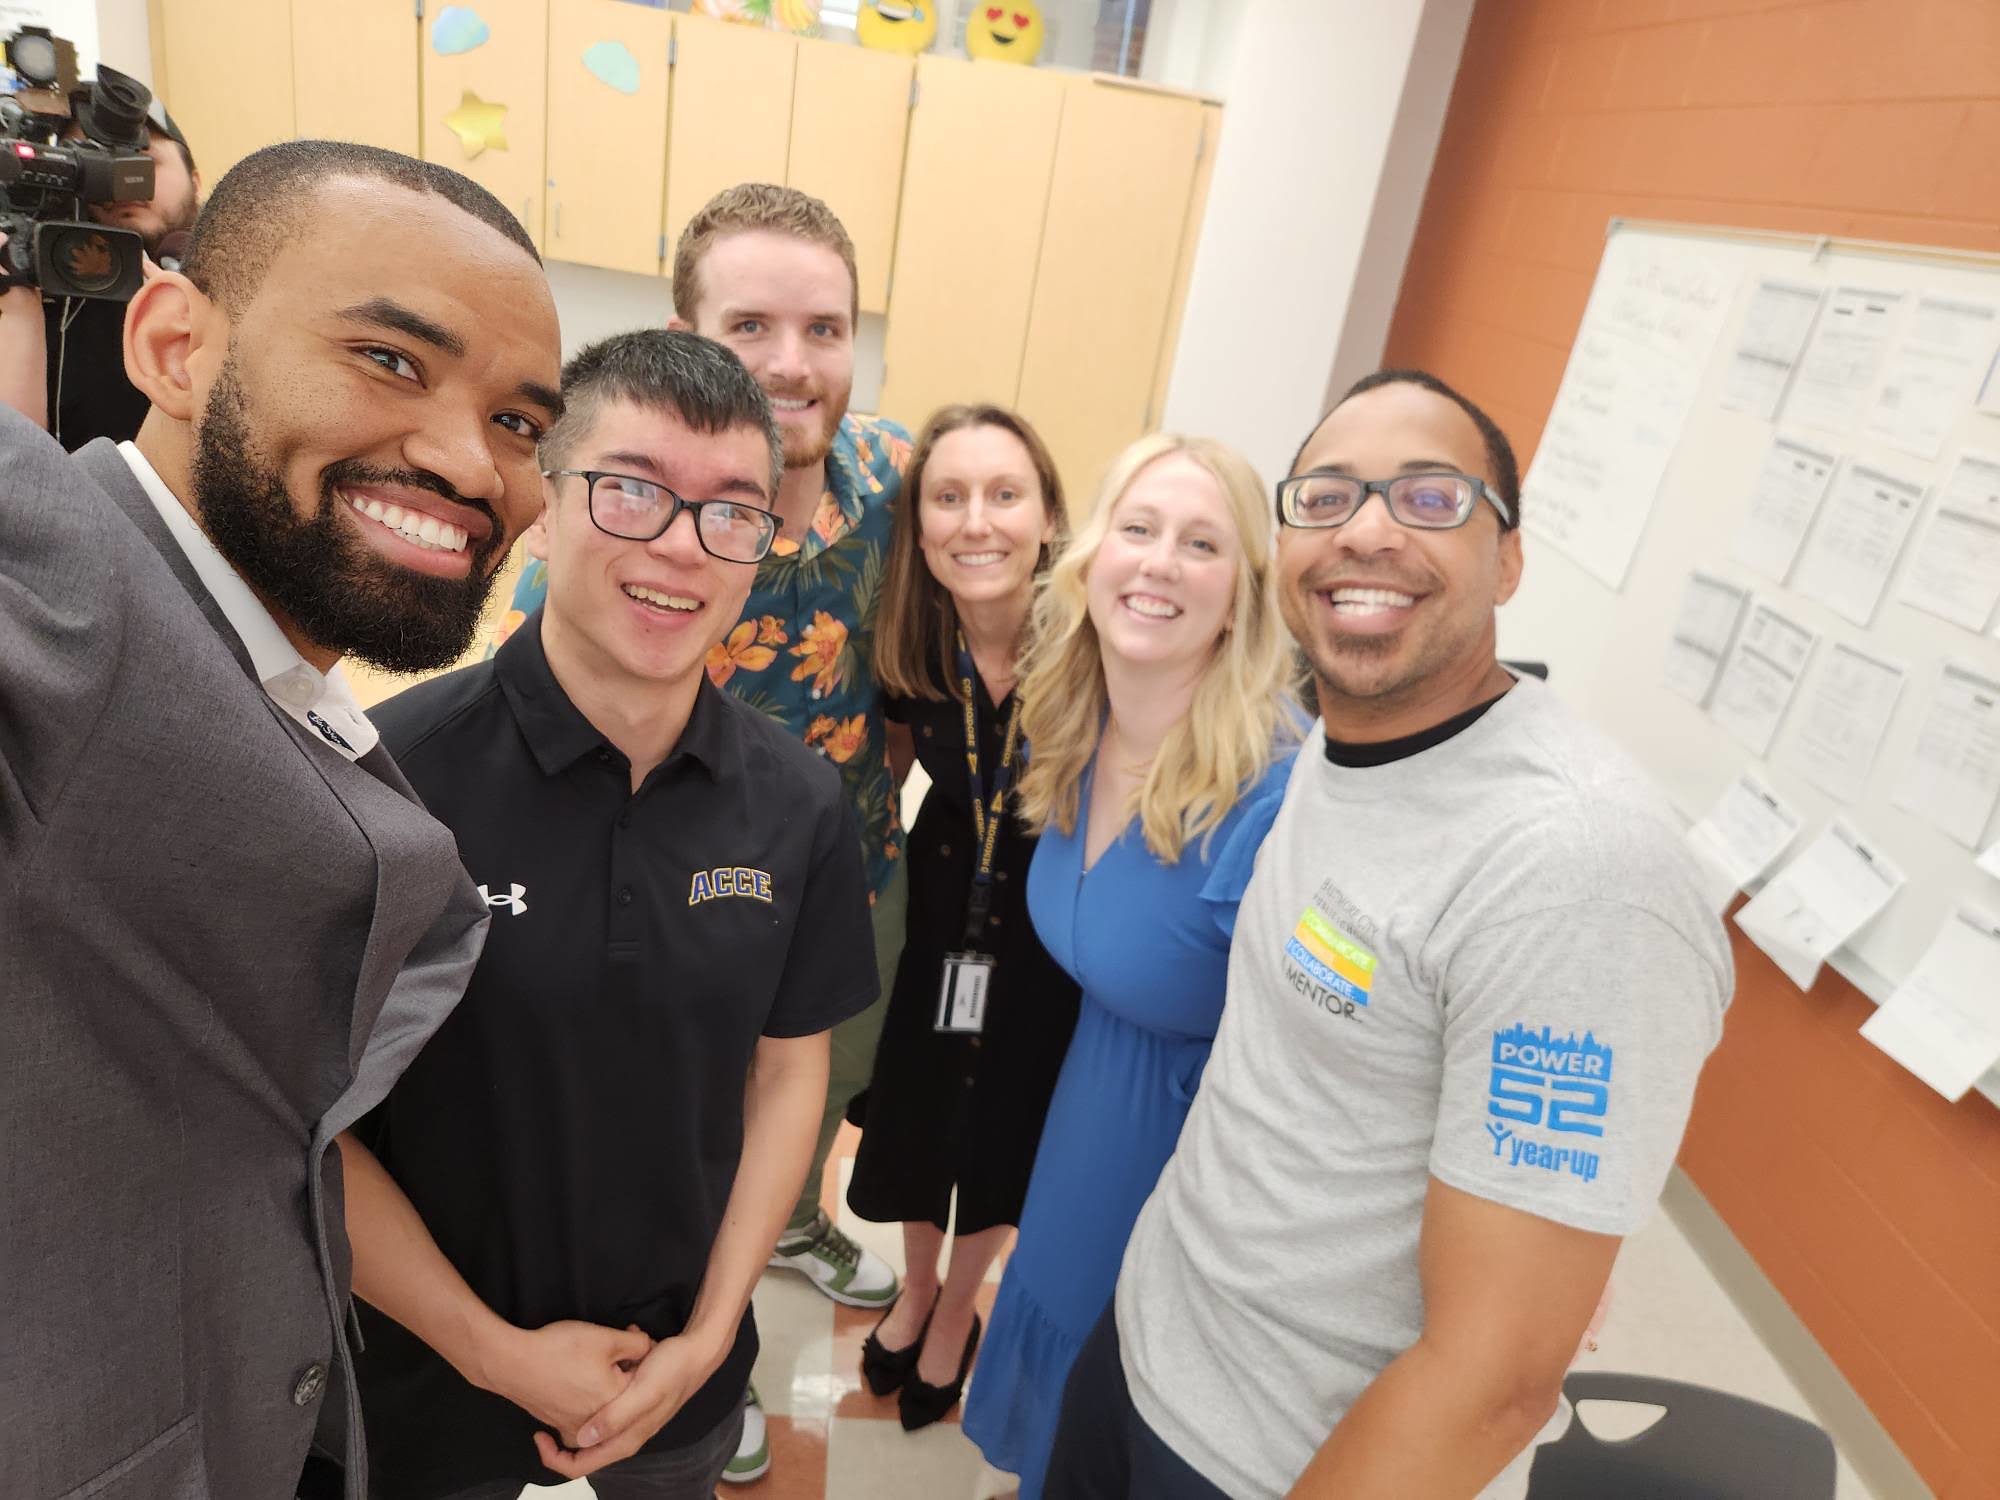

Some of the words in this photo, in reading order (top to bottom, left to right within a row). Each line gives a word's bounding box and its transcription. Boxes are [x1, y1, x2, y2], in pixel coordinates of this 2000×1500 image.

[688, 867, 772, 905] ACCE
[1286, 966, 1363, 1024] MENTOR
[1290, 940, 1352, 1000] COLLABORATE
[1501, 1043, 1603, 1075] POWER
[1488, 1067, 1608, 1138] 52
